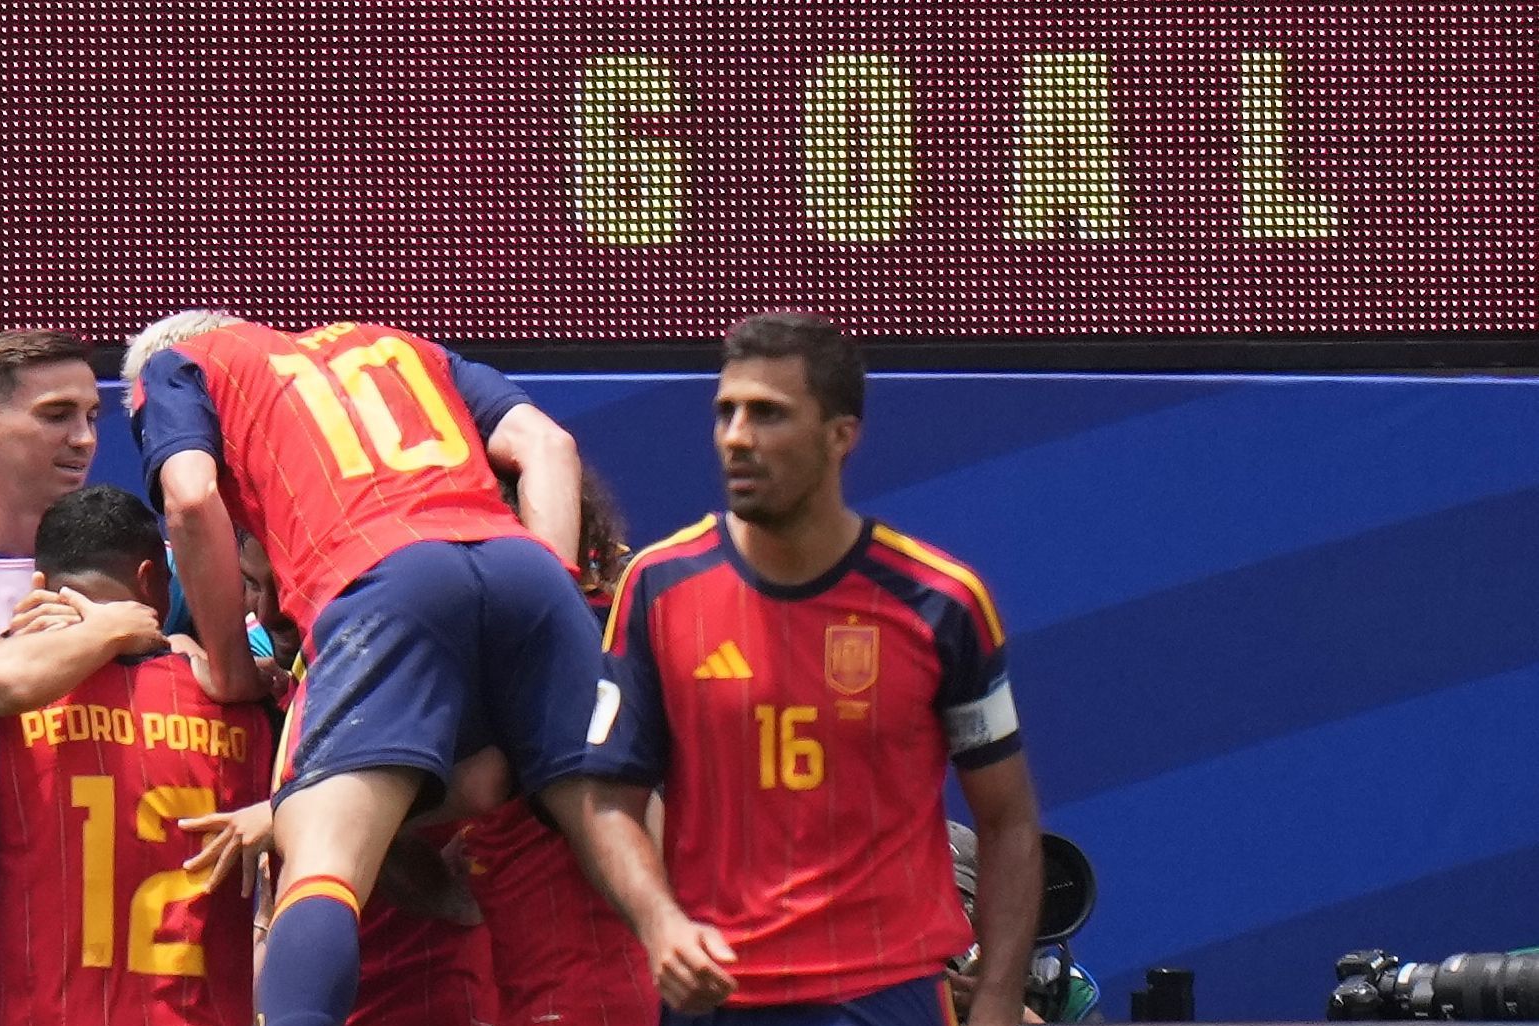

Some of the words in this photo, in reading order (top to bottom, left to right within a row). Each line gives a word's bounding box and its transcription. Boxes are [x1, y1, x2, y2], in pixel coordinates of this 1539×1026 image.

[574, 52, 1347, 247] GOAL
[269, 337, 471, 480] 10
[20, 704, 136, 748] PEDRO
[754, 704, 826, 790] 16
[70, 775, 218, 977] 12
